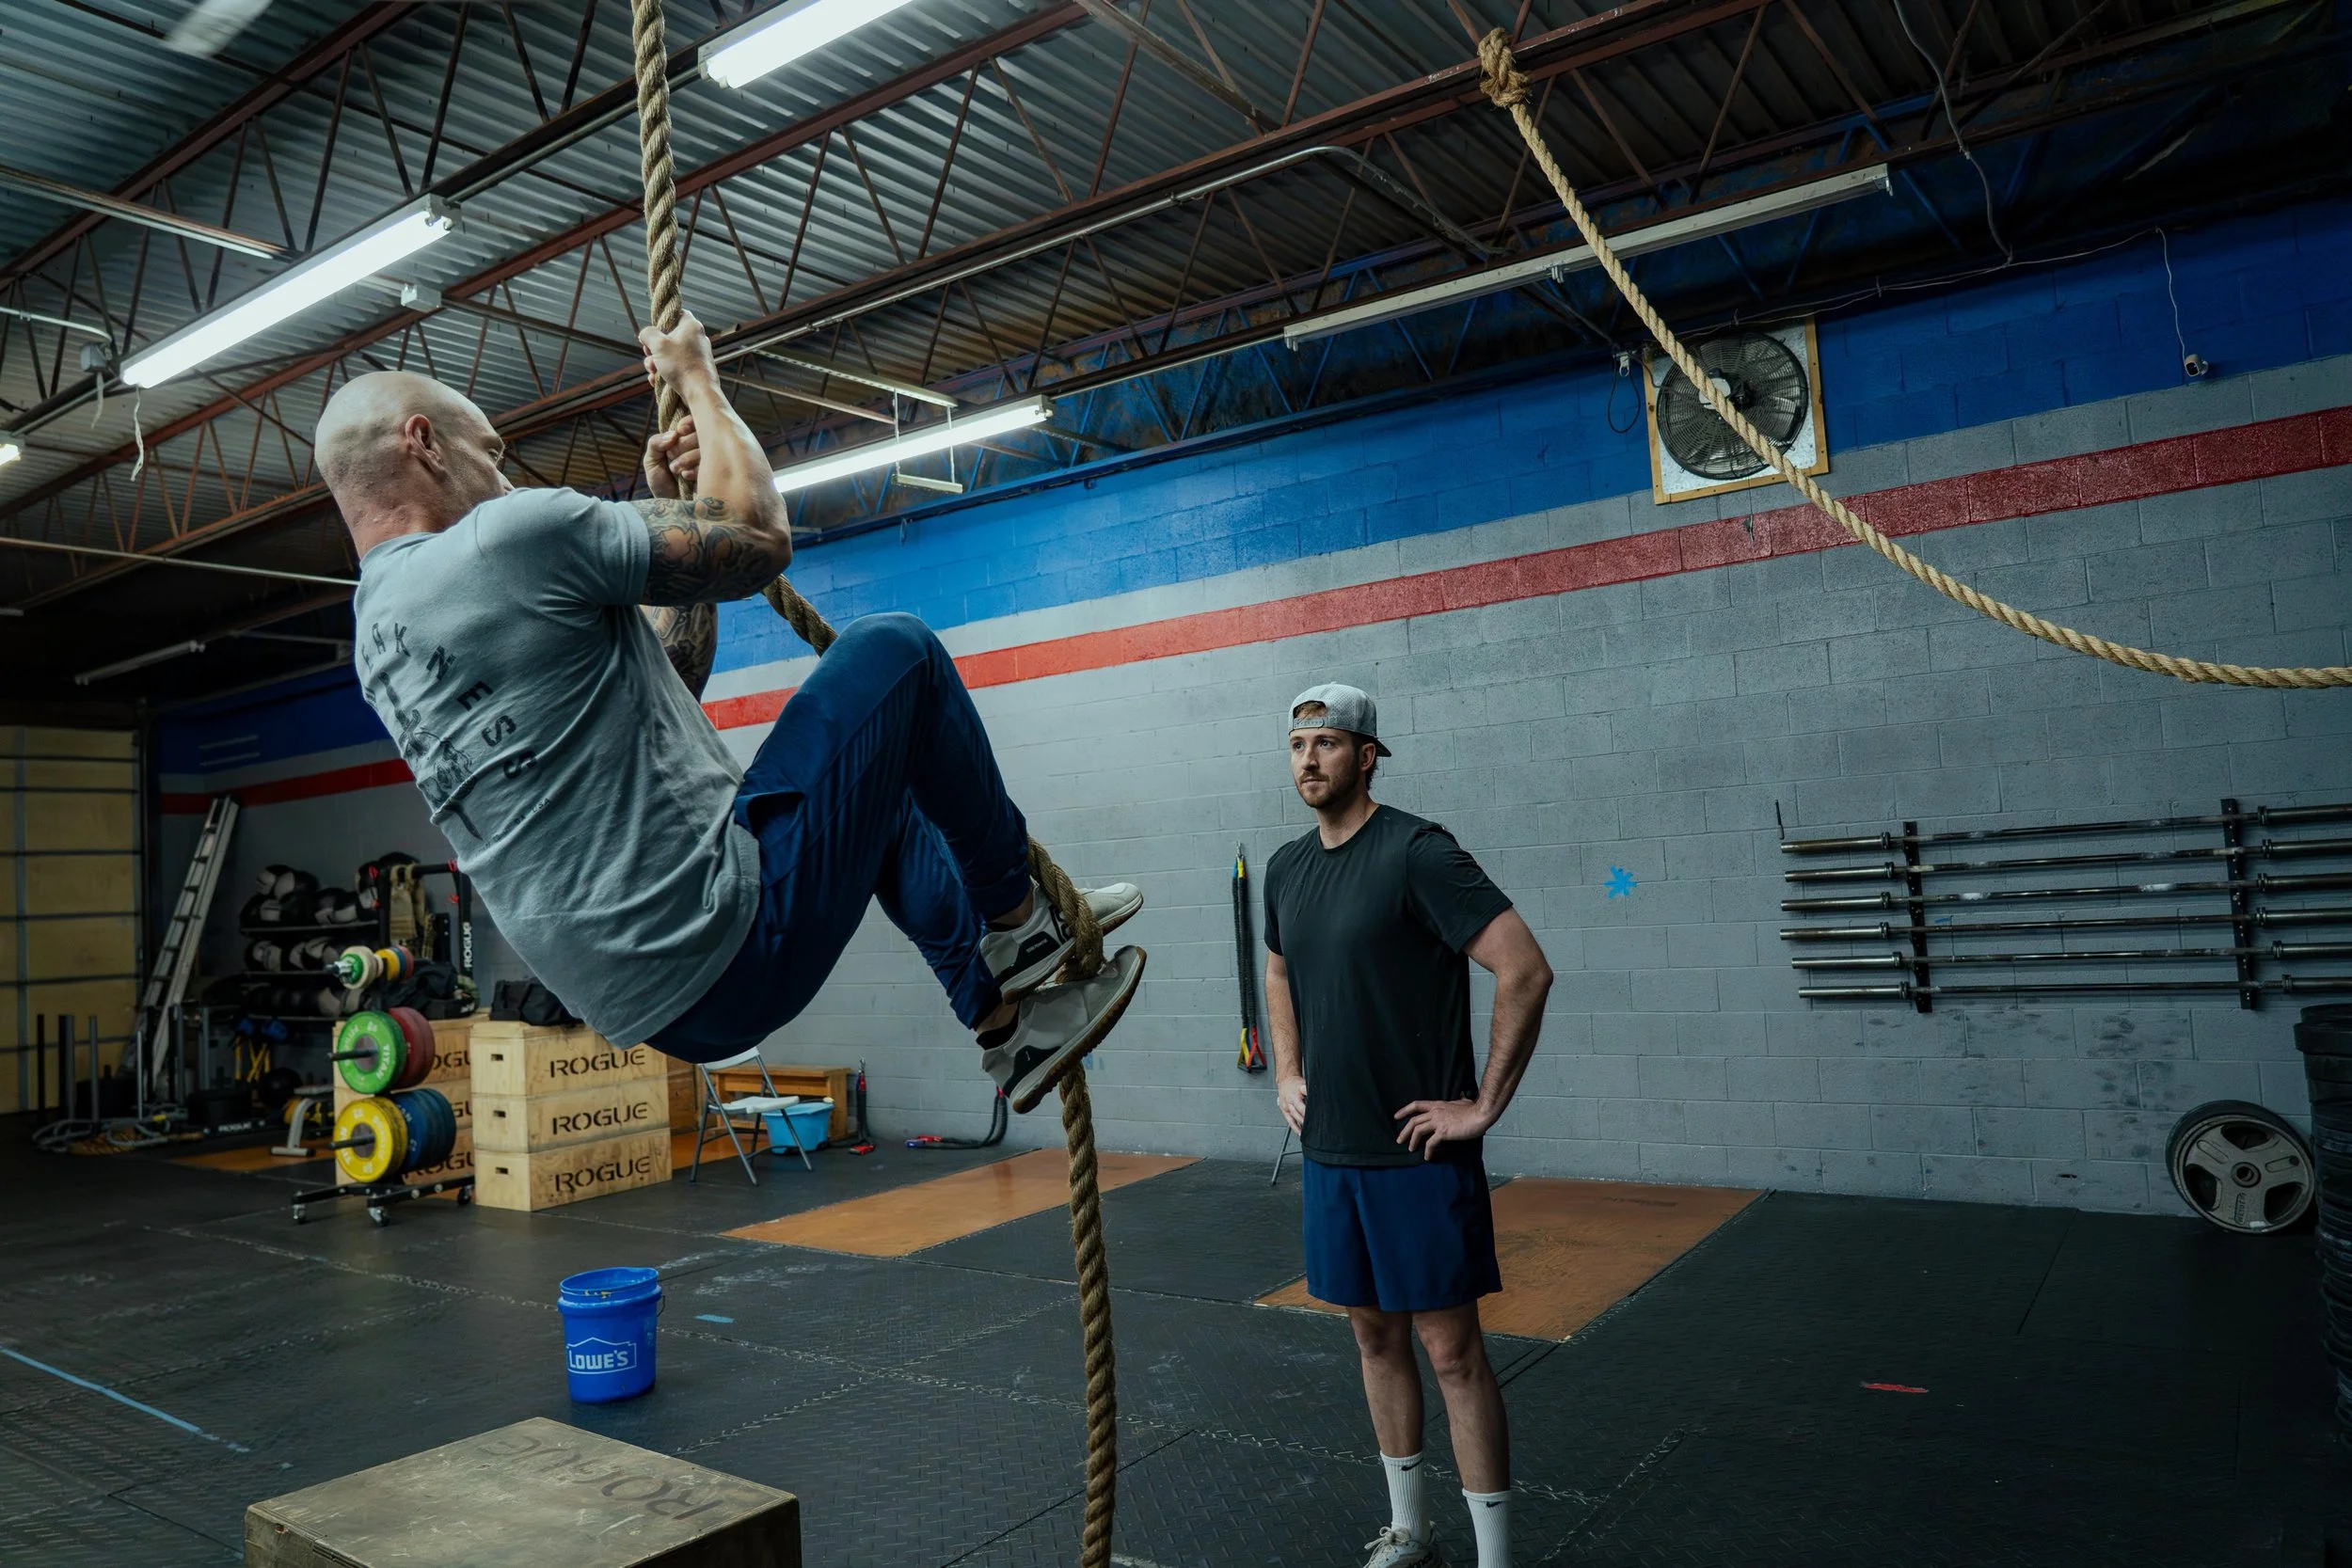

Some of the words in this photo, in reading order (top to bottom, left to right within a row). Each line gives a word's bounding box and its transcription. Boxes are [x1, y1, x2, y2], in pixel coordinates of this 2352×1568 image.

[463, 922, 473, 968] ROGUE
[549, 1048, 645, 1078] ROGUE
[552, 1101, 648, 1135] ROGUE
[555, 1155, 651, 1193] ROGUE
[568, 1350, 628, 1370] LOWE'S
